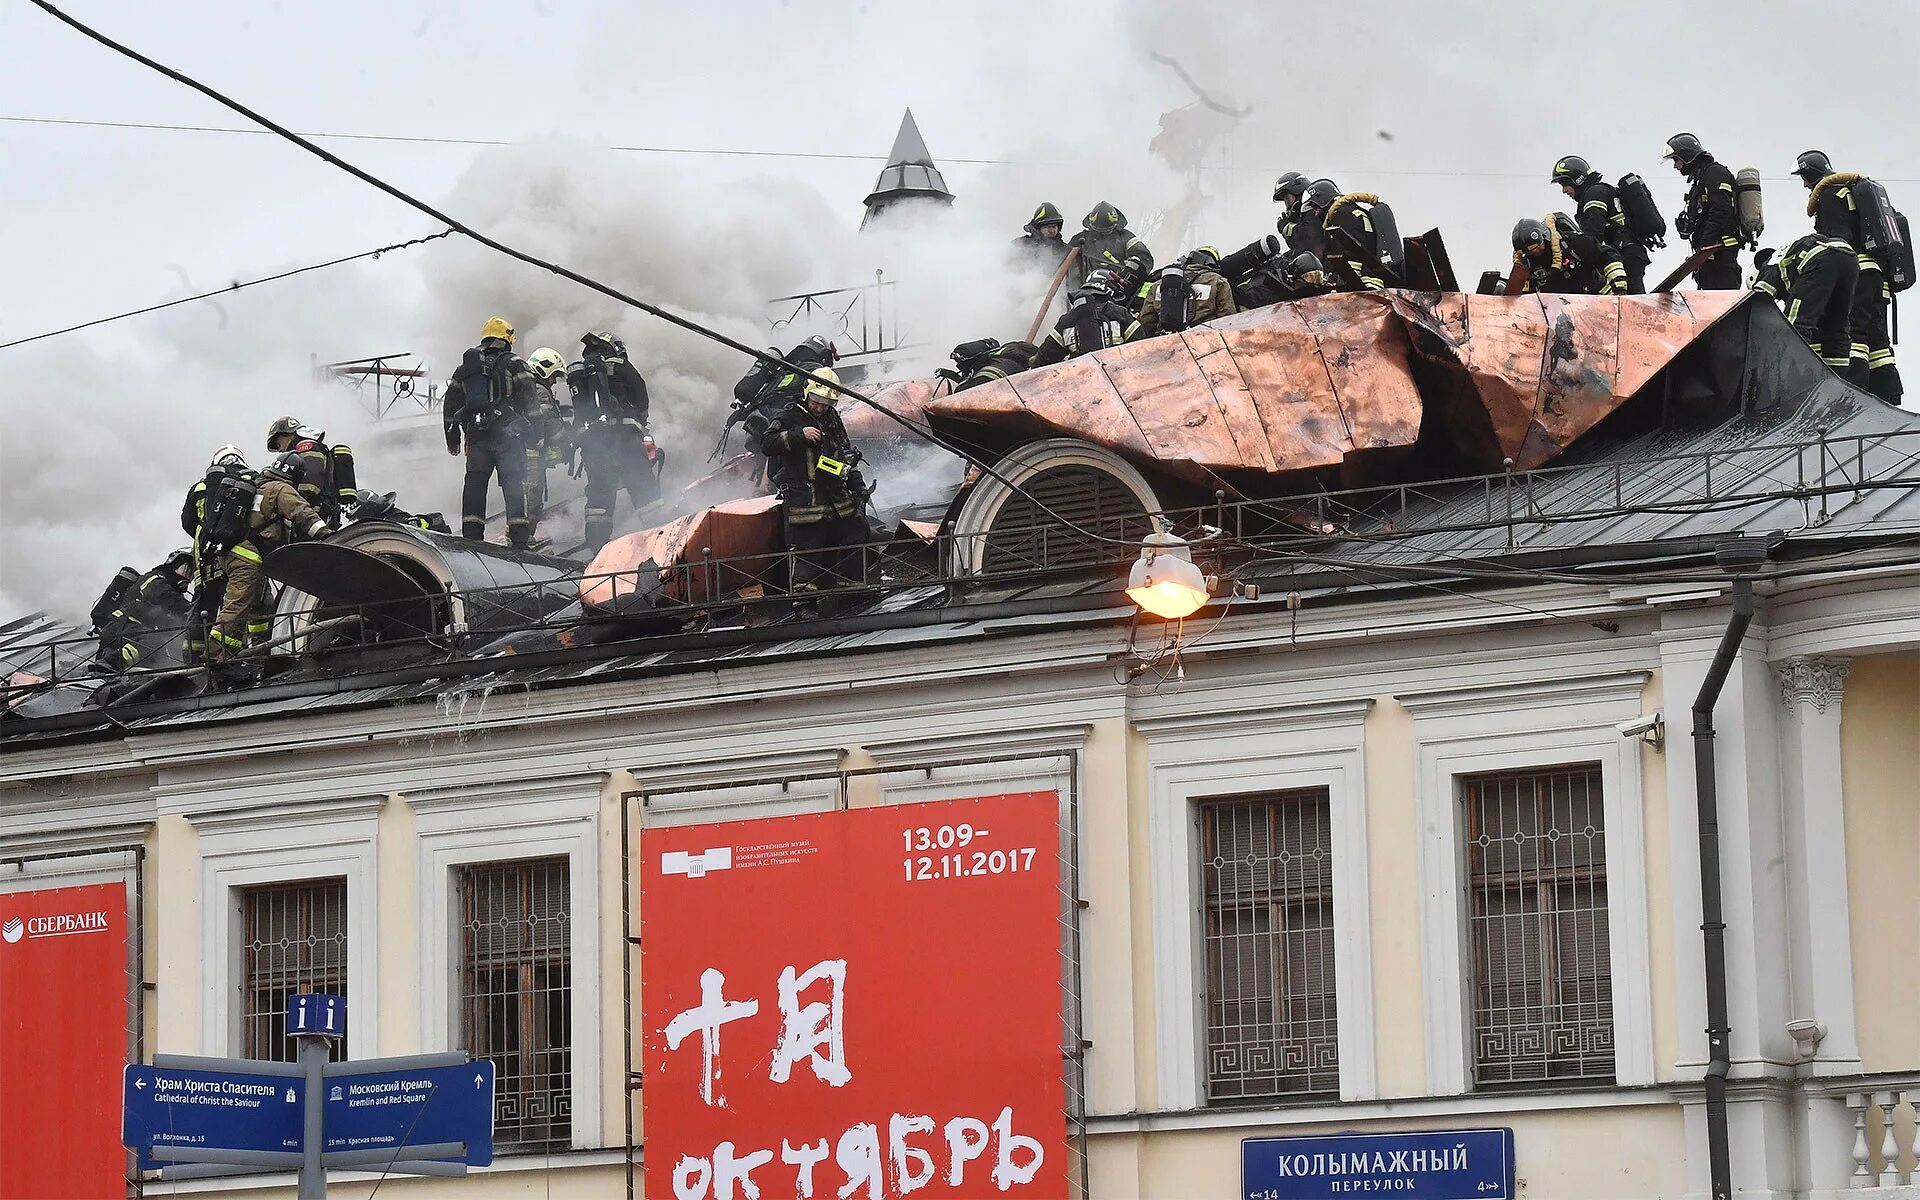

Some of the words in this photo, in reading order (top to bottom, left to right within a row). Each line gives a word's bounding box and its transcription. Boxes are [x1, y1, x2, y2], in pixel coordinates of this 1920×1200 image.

[903, 847, 1036, 881] 12.11.2017
[28, 911, 108, 933] СБЕРБАНК
[664, 958, 853, 1106] 十月
[155, 1077, 183, 1093] Храм
[184, 1078, 221, 1094] Христа
[222, 1081, 275, 1097] Спасителя
[349, 1081, 400, 1095] Московский
[401, 1079, 433, 1093] Кремль
[154, 1093, 189, 1104] Cathedral
[190, 1096, 199, 1104] of
[199, 1096, 220, 1106] Christ
[221, 1096, 234, 1106] the
[234, 1098, 260, 1109] Saviour
[349, 1097, 375, 1108] Kremlin
[375, 1096, 389, 1106] and
[389, 1095, 402, 1104] Red
[402, 1093, 426, 1105] Square
[282, 1139, 287, 1147] 4
[287, 1139, 298, 1147] min
[335, 1137, 346, 1146] min
[348, 1137, 370, 1146] Красная
[370, 1136, 395, 1145] площадь
[1278, 1143, 1468, 1177] КОЛЫМАЖНЫЙ
[1331, 1178, 1416, 1193] ПЕРЕУЛОК
[1477, 1181, 1485, 1192] 4
[1263, 1189, 1278, 1200] 14
